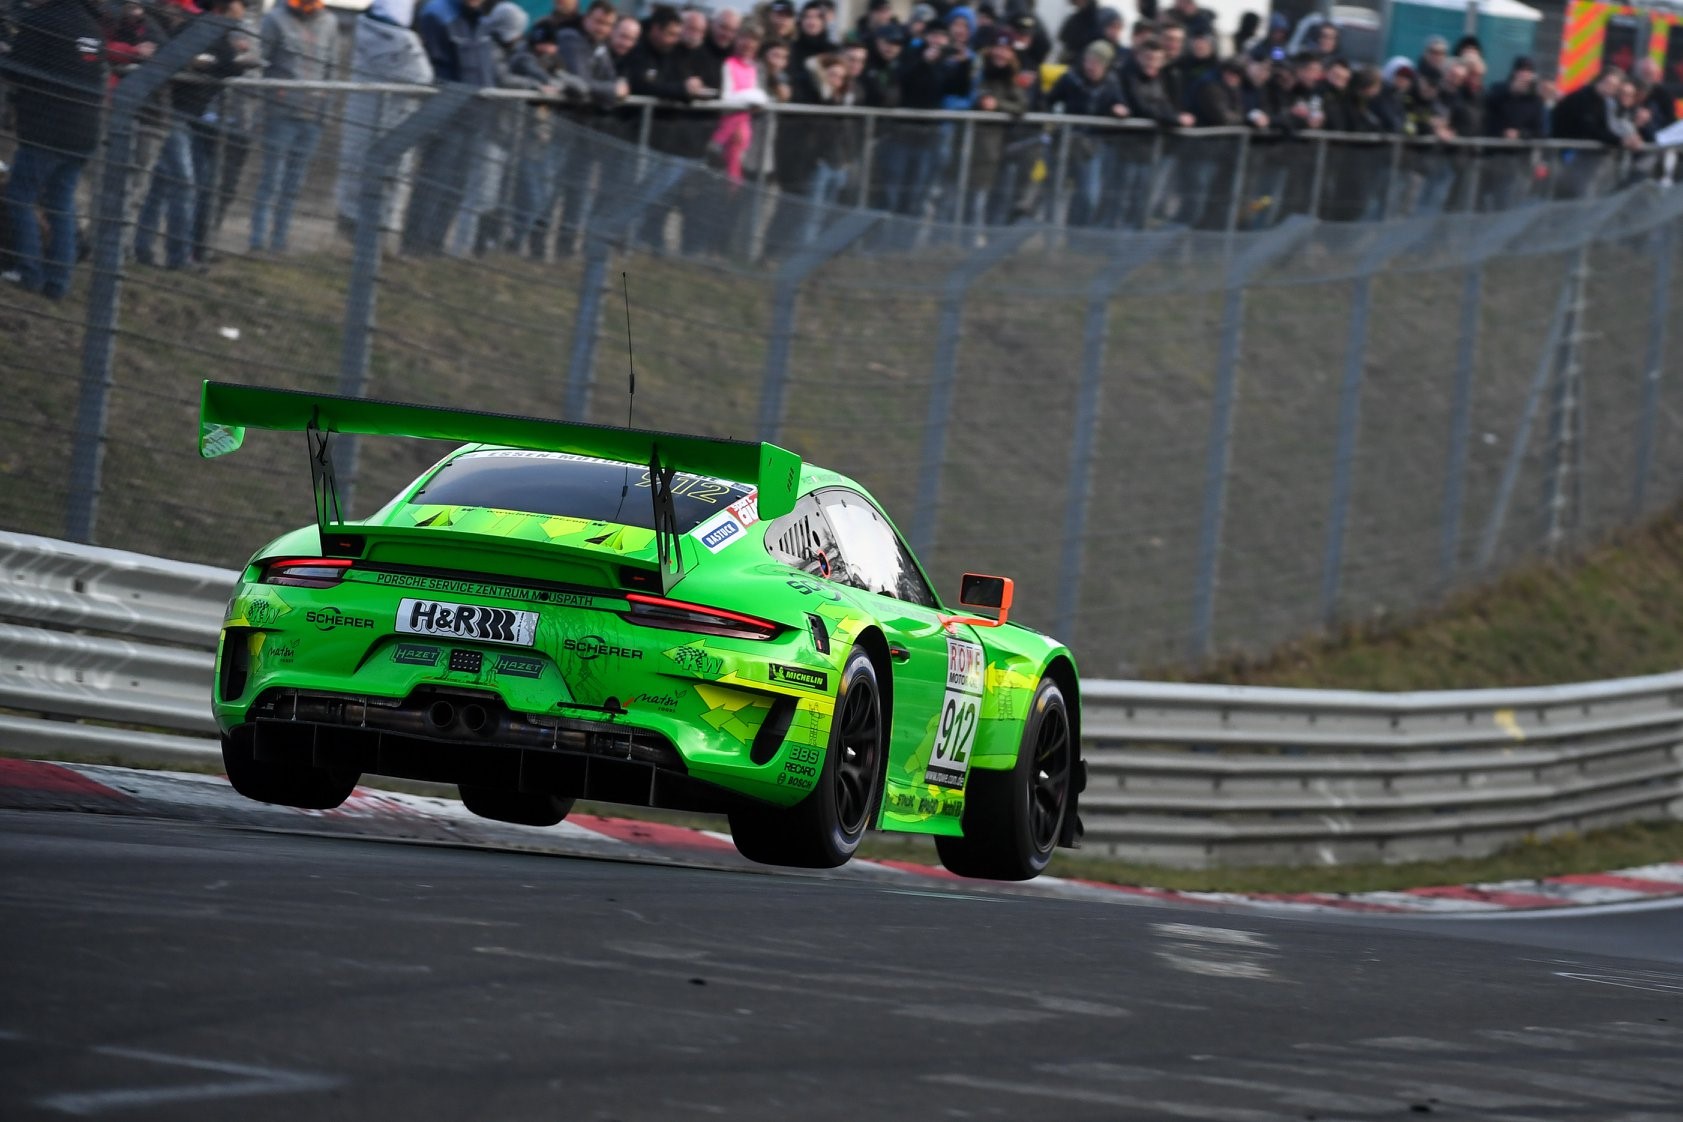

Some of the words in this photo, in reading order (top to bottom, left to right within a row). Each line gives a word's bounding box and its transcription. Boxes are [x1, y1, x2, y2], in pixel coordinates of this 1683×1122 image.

[705, 523, 738, 546] BASTUCK
[377, 573, 427, 588] PORSCHE
[428, 578, 474, 594] SERVICE
[477, 583, 530, 600] ZENTRUM
[531, 588, 594, 606] MUSPATH
[306, 610, 375, 629] SCHERER
[395, 647, 439, 663] HAZET
[563, 638, 644, 660] SCHERER
[497, 659, 541, 674] HAZET
[950, 645, 981, 675] ROWE
[785, 671, 824, 686] MICHELIN
[949, 672, 968, 686] MOTOR
[936, 698, 976, 763] 912
[790, 745, 820, 765] BBS
[784, 761, 816, 777] RECARO
[788, 775, 813, 789] BOSCH
